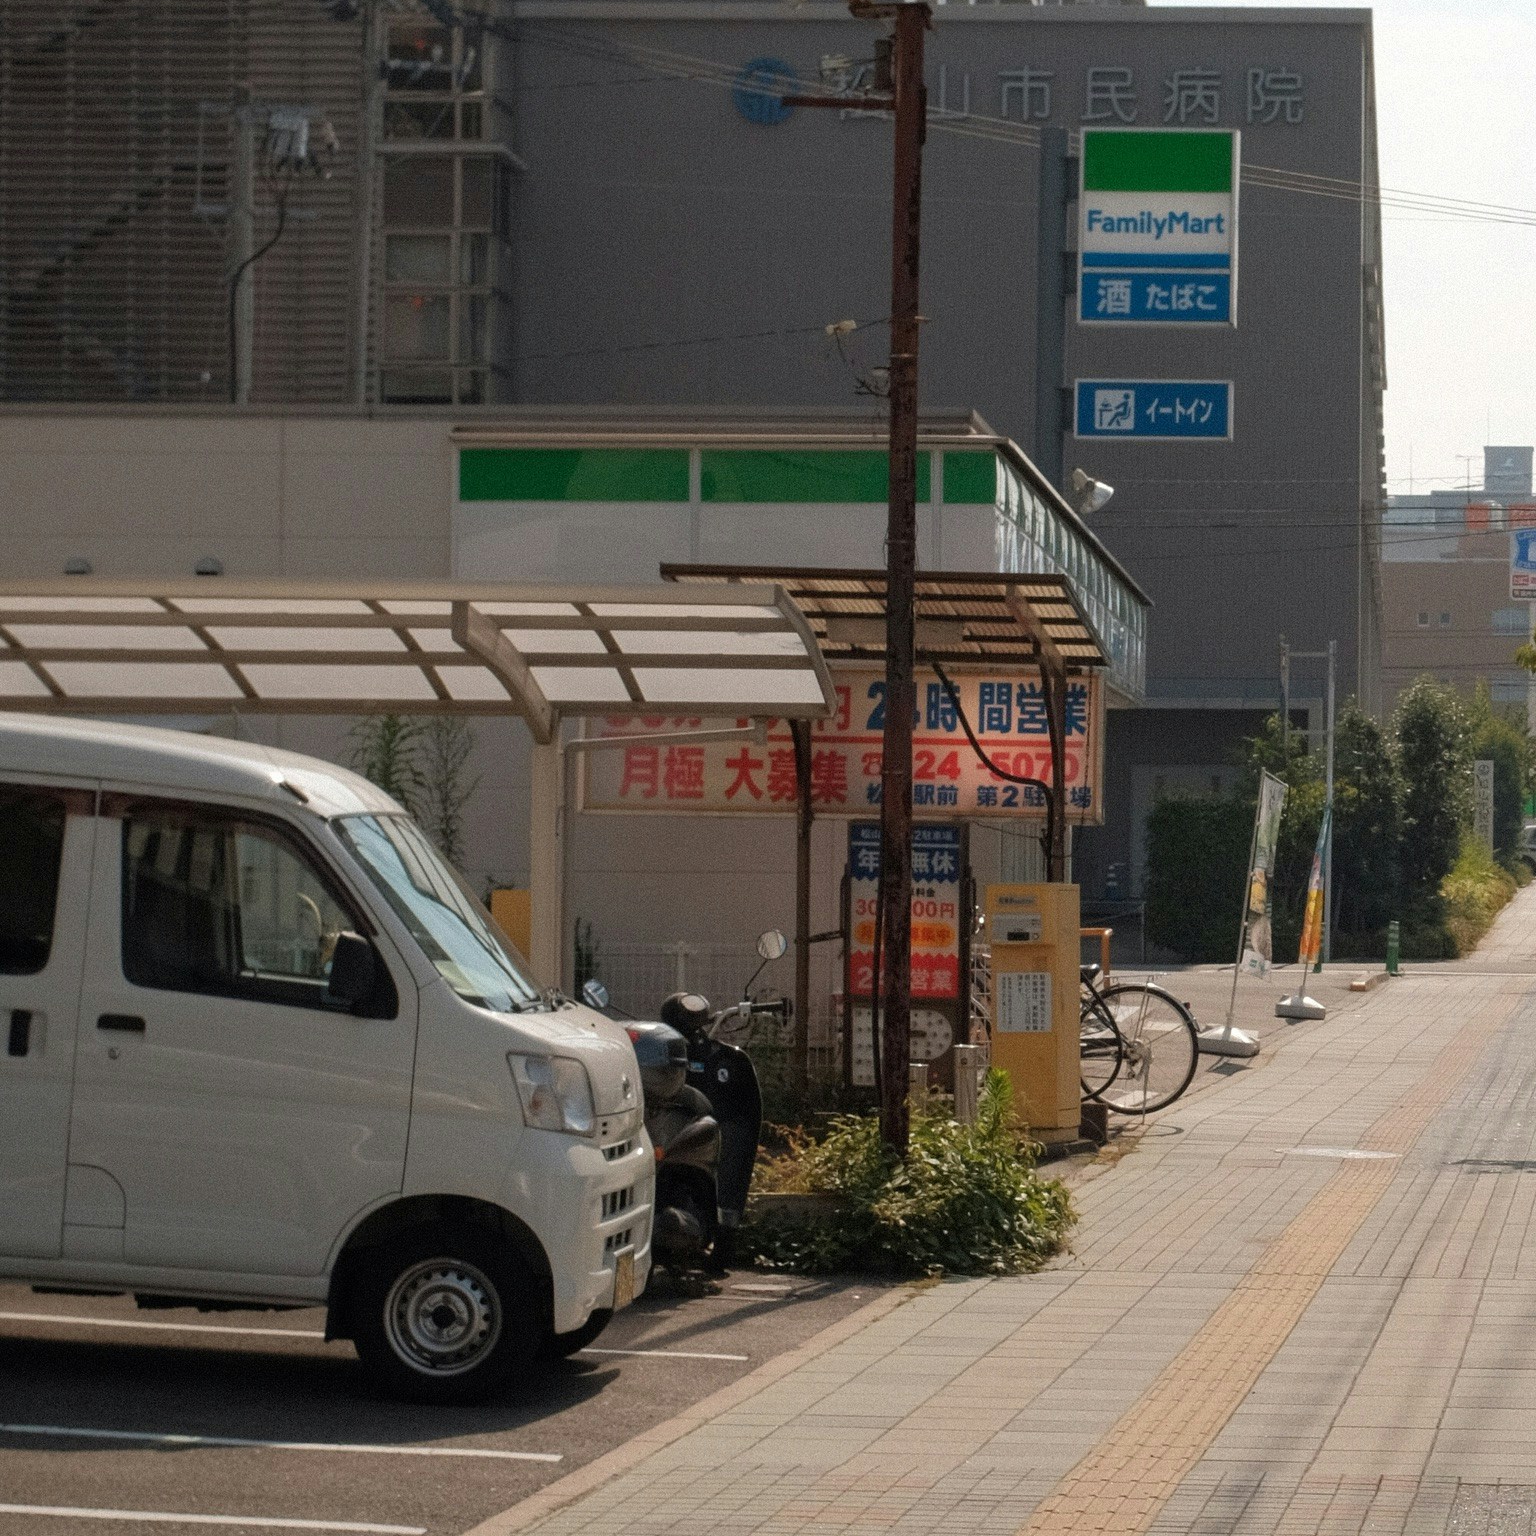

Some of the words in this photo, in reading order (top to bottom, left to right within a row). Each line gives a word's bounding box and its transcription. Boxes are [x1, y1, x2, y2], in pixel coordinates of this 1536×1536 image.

[1087, 211, 1224, 239] FamilyMart
[1097, 280, 1131, 314] 酒
[1146, 283, 1218, 311] たばこ
[1146, 399, 1212, 425] イートイン
[857, 848, 955, 874] 年無休
